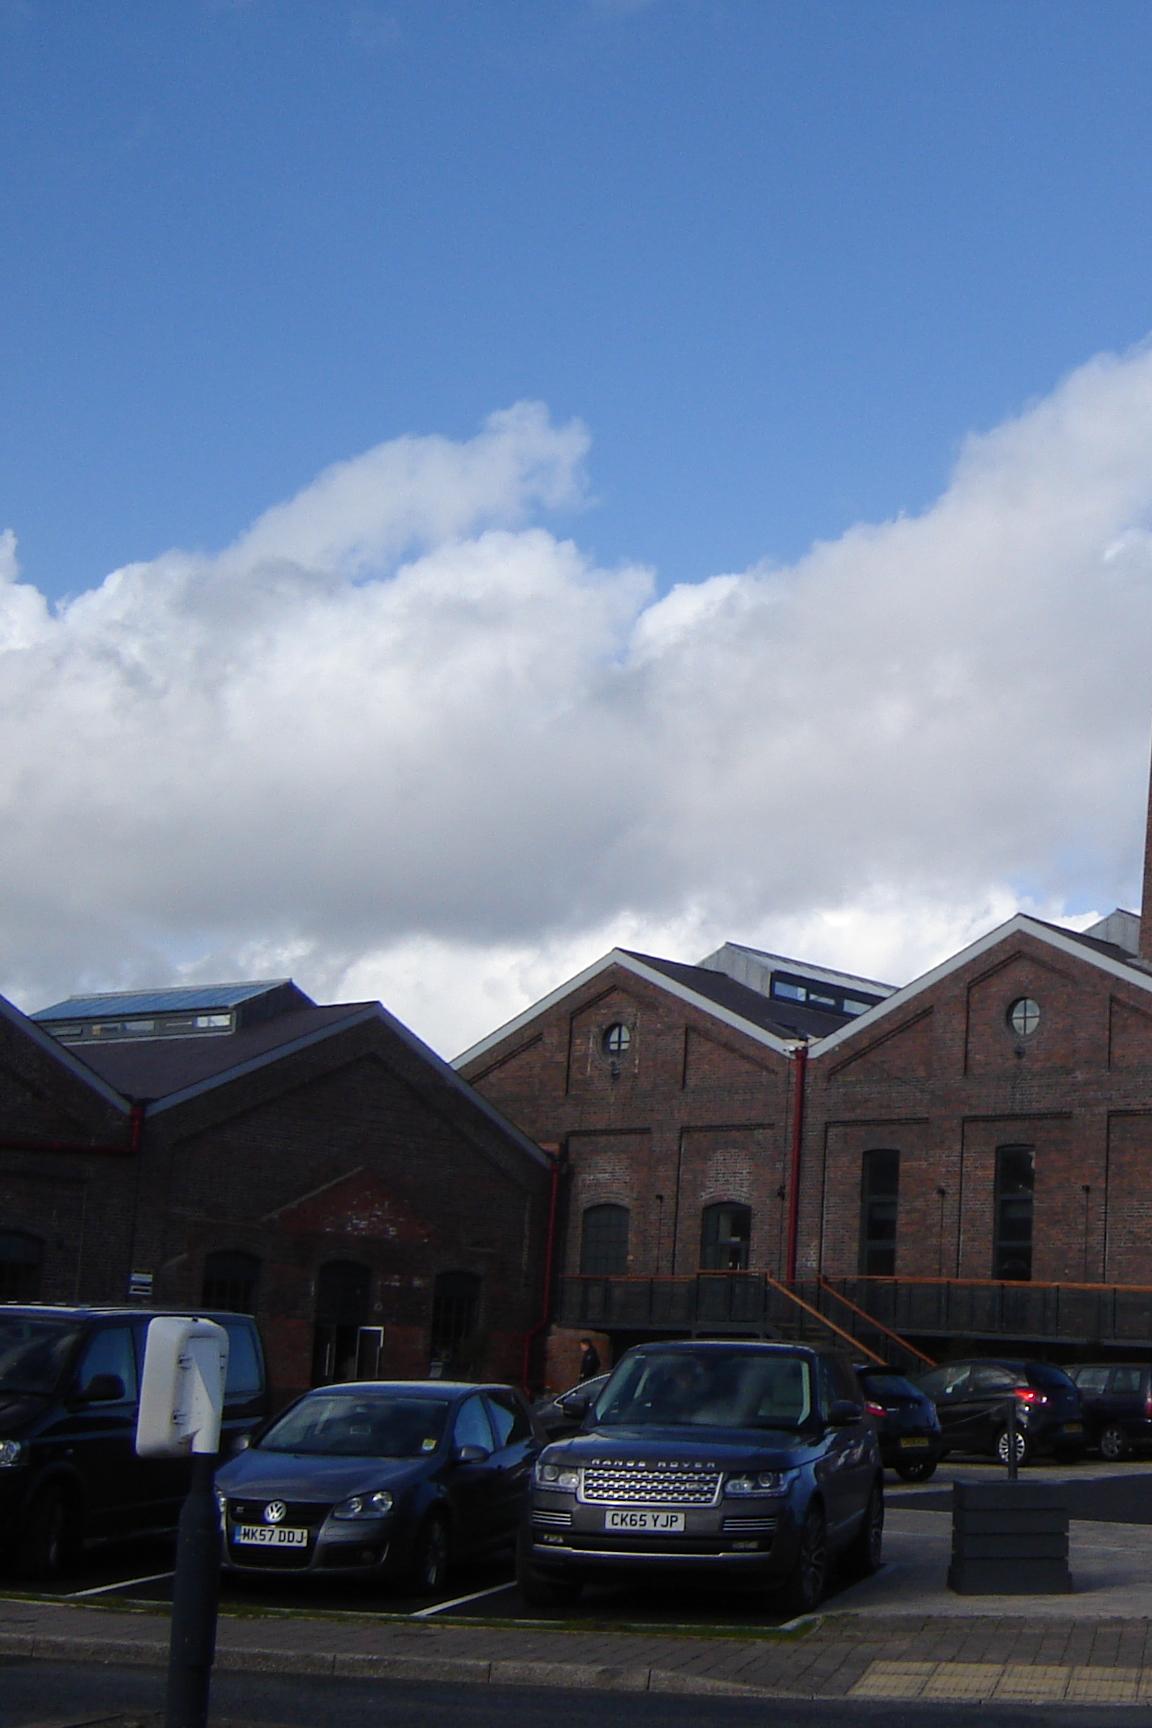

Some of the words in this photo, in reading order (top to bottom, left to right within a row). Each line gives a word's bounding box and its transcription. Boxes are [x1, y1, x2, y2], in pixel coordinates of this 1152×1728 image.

[592, 1459, 646, 1467] RANGE
[611, 1513, 647, 1527] CK65
[651, 1514, 678, 1529] YJP
[242, 1528, 275, 1542] MK57
